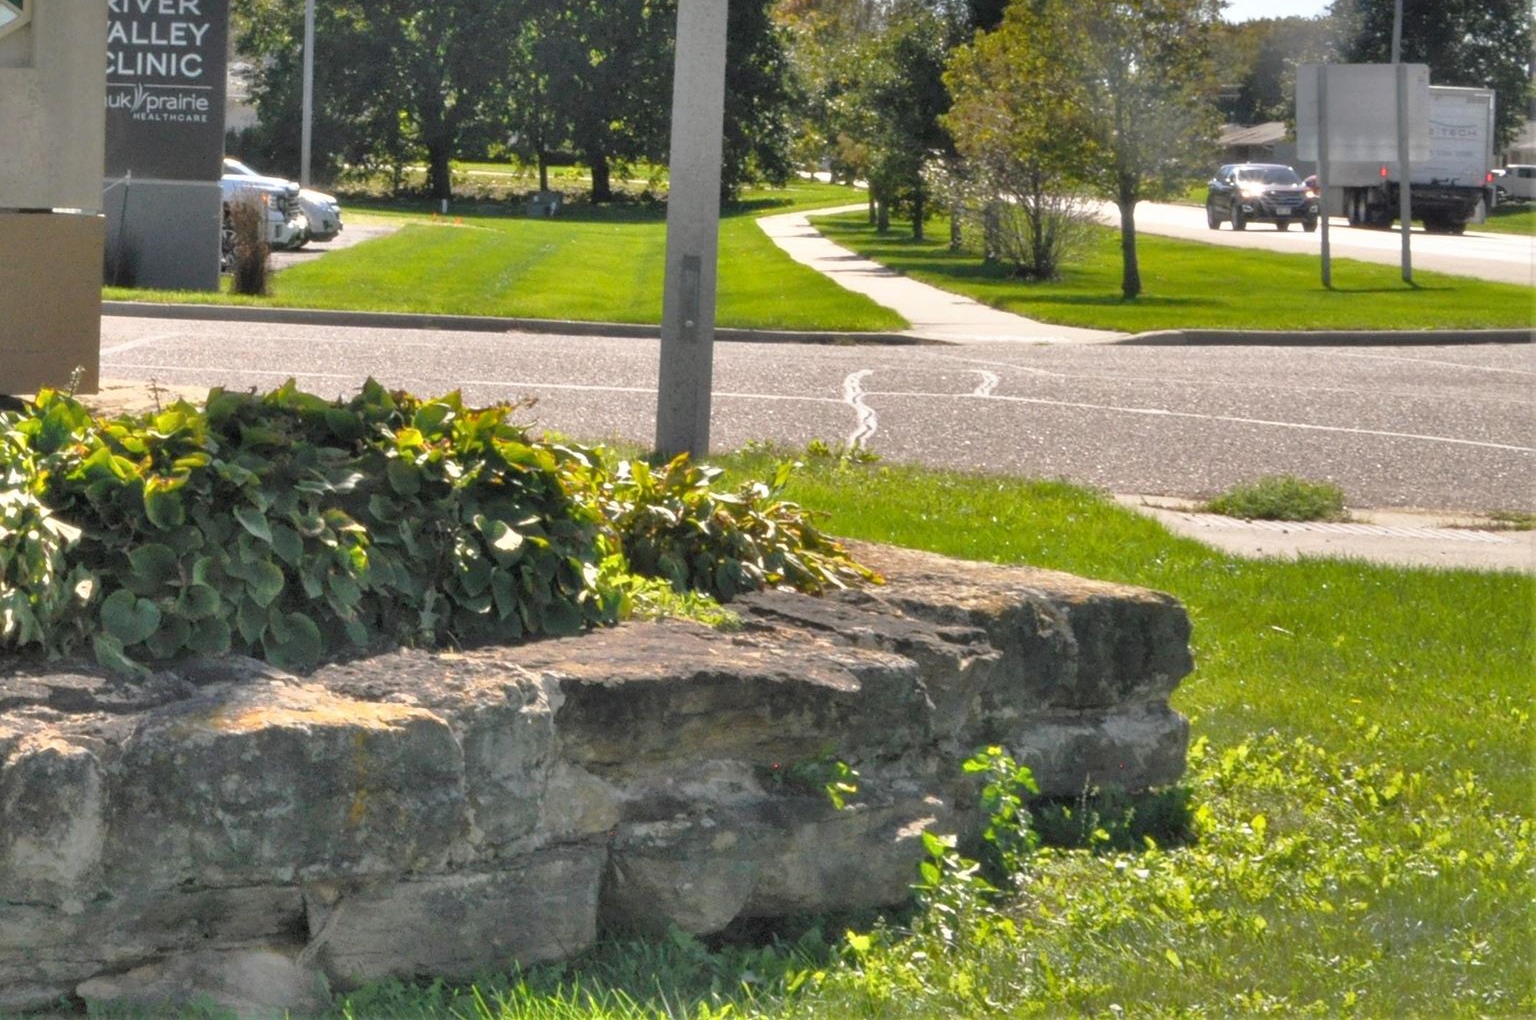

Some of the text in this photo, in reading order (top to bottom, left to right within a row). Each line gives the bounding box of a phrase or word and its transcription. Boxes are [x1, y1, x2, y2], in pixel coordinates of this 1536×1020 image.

[106, 20, 211, 47] ALLEY
[146, 93, 209, 113] prairie
[132, 112, 208, 123] HEALTHCARE
